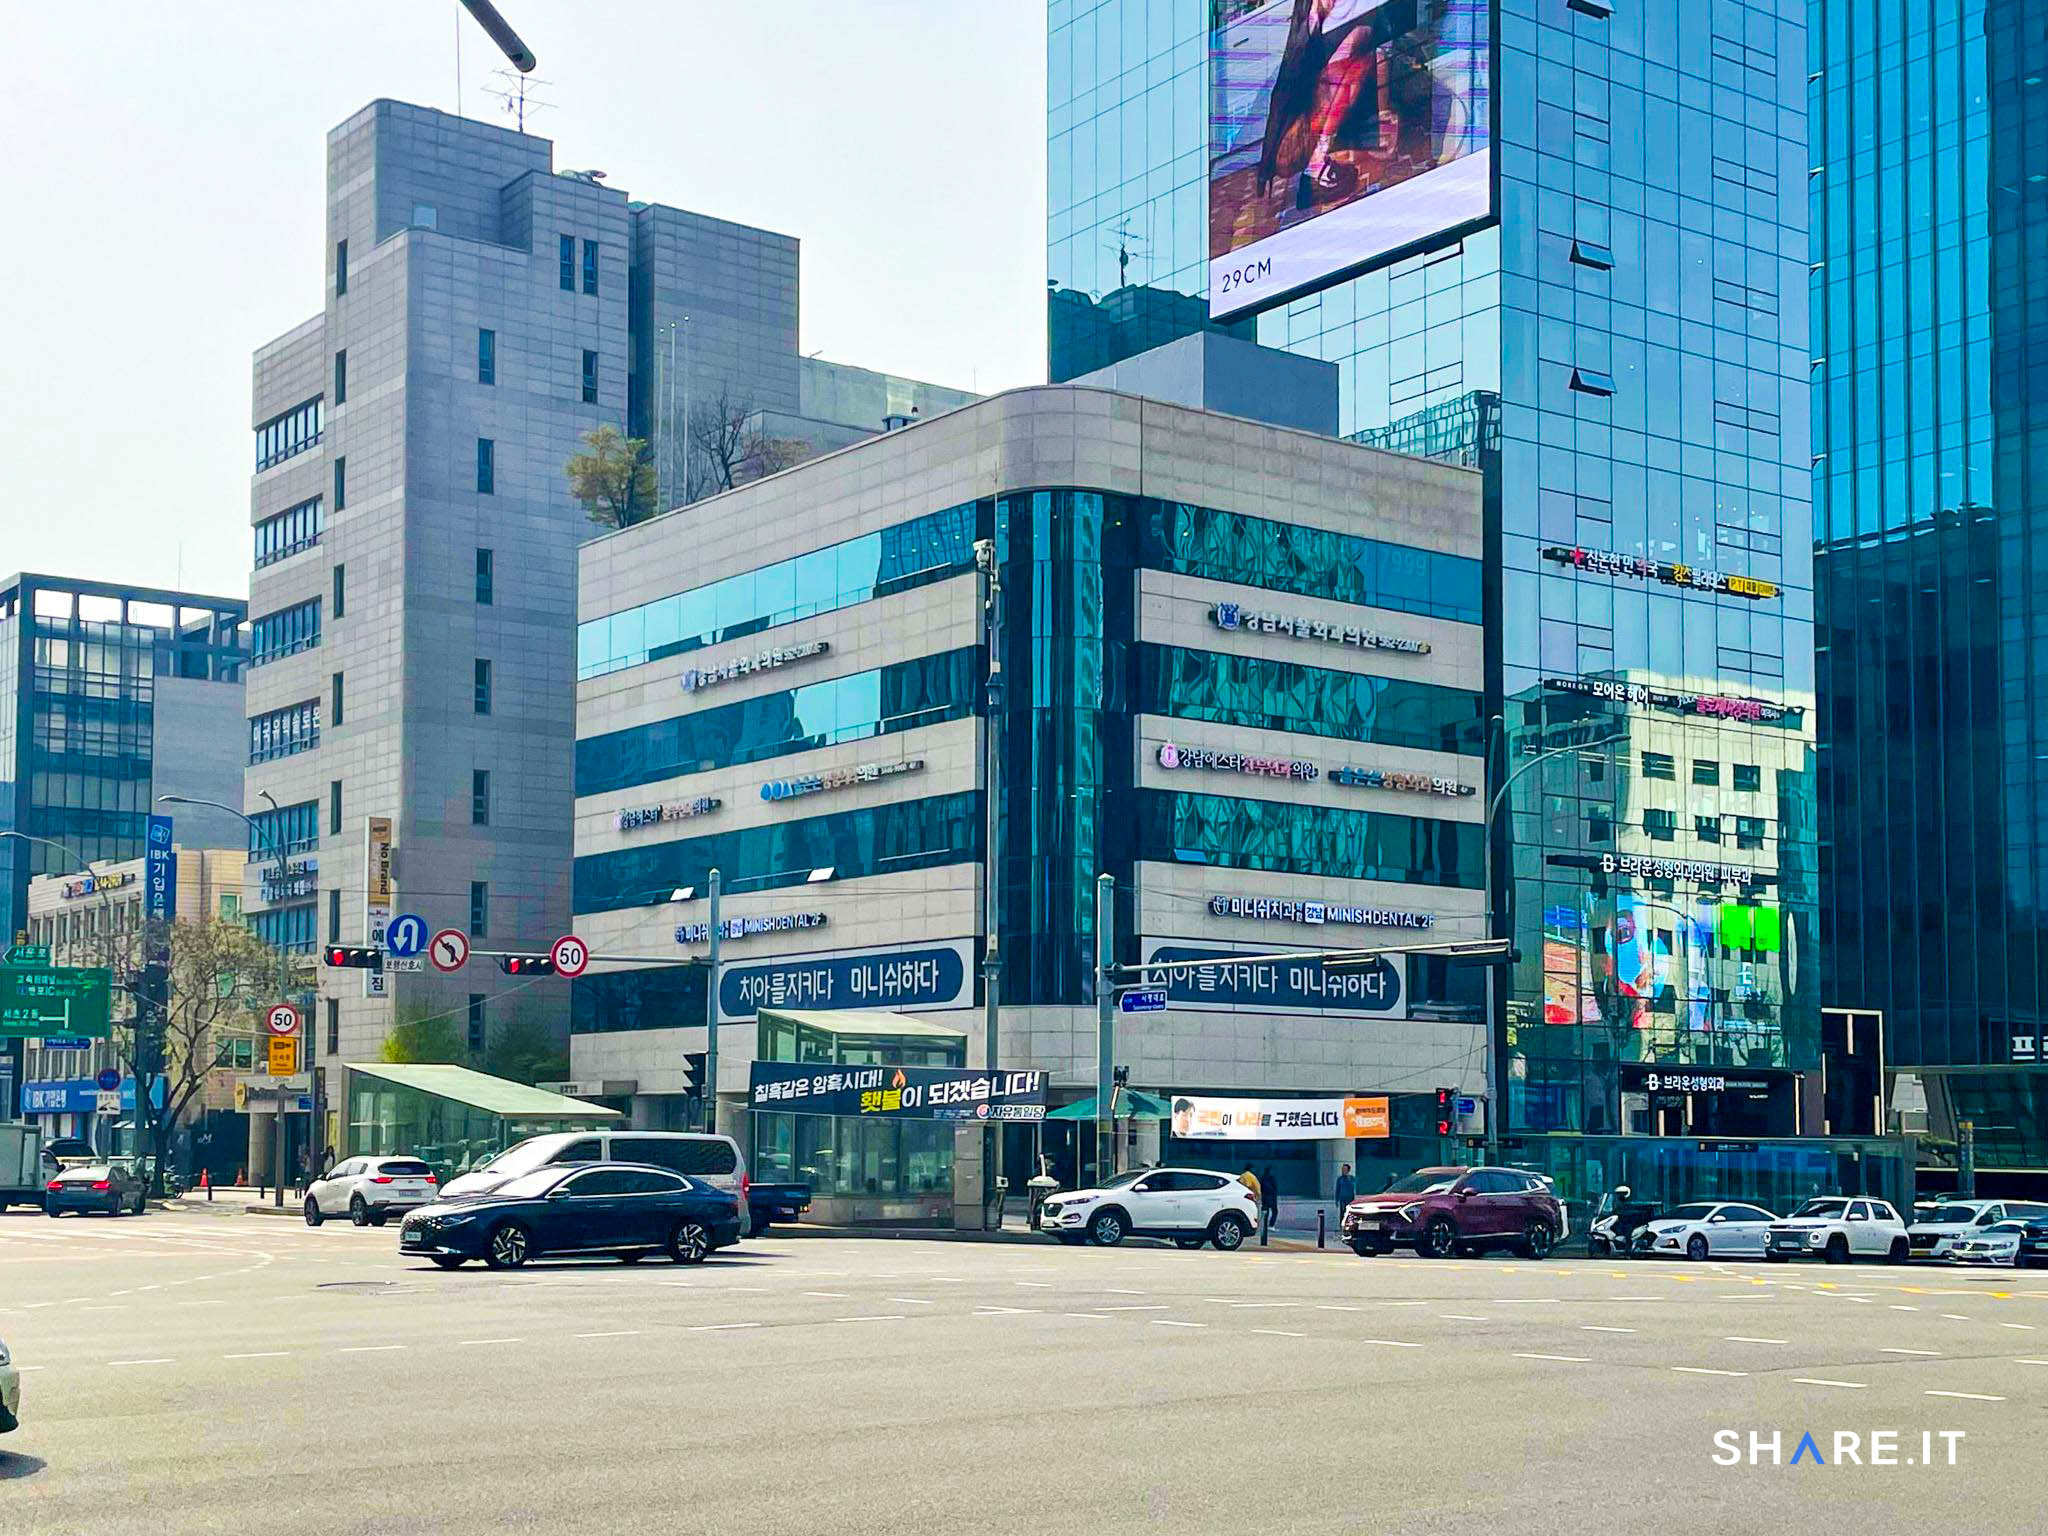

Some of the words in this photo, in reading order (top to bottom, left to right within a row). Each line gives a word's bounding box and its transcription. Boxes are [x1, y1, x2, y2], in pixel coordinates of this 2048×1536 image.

[1222, 257, 1271, 293] 29CM
[1245, 611, 1377, 648] 강남서울외과의원
[1592, 681, 1626, 701] 모어온
[1627, 684, 1649, 705] 헤어
[150, 849, 169, 860] IBK
[380, 842, 390, 859] No
[380, 860, 390, 896] Brand
[1619, 855, 1715, 883] 브라운성형외과의원
[1720, 864, 1752, 886] 피부과
[1231, 898, 1295, 921] 미니쉬치과
[1305, 906, 1323, 920] 강남
[1327, 906, 1372, 925] MINISH
[1373, 910, 1419, 928] DENTAL
[559, 947, 581, 966] 50
[739, 968, 834, 1006] 치아를지키다
[851, 959, 939, 999] 미니쉬하다
[1290, 967, 1386, 1000] 미니쉬하다
[274, 1013, 292, 1027] 50
[755, 1078, 810, 1103] 칠흑같은
[813, 1069, 884, 1096] 암흑시대!
[861, 1086, 922, 1114] 횃불이
[928, 1071, 1040, 1105] 되겠습니다!
[1664, 1075, 1725, 1092] 브라운성형외과
[990, 1105, 1046, 1119] 자유통일당
[1275, 1112, 1339, 1128] 구했습니다
